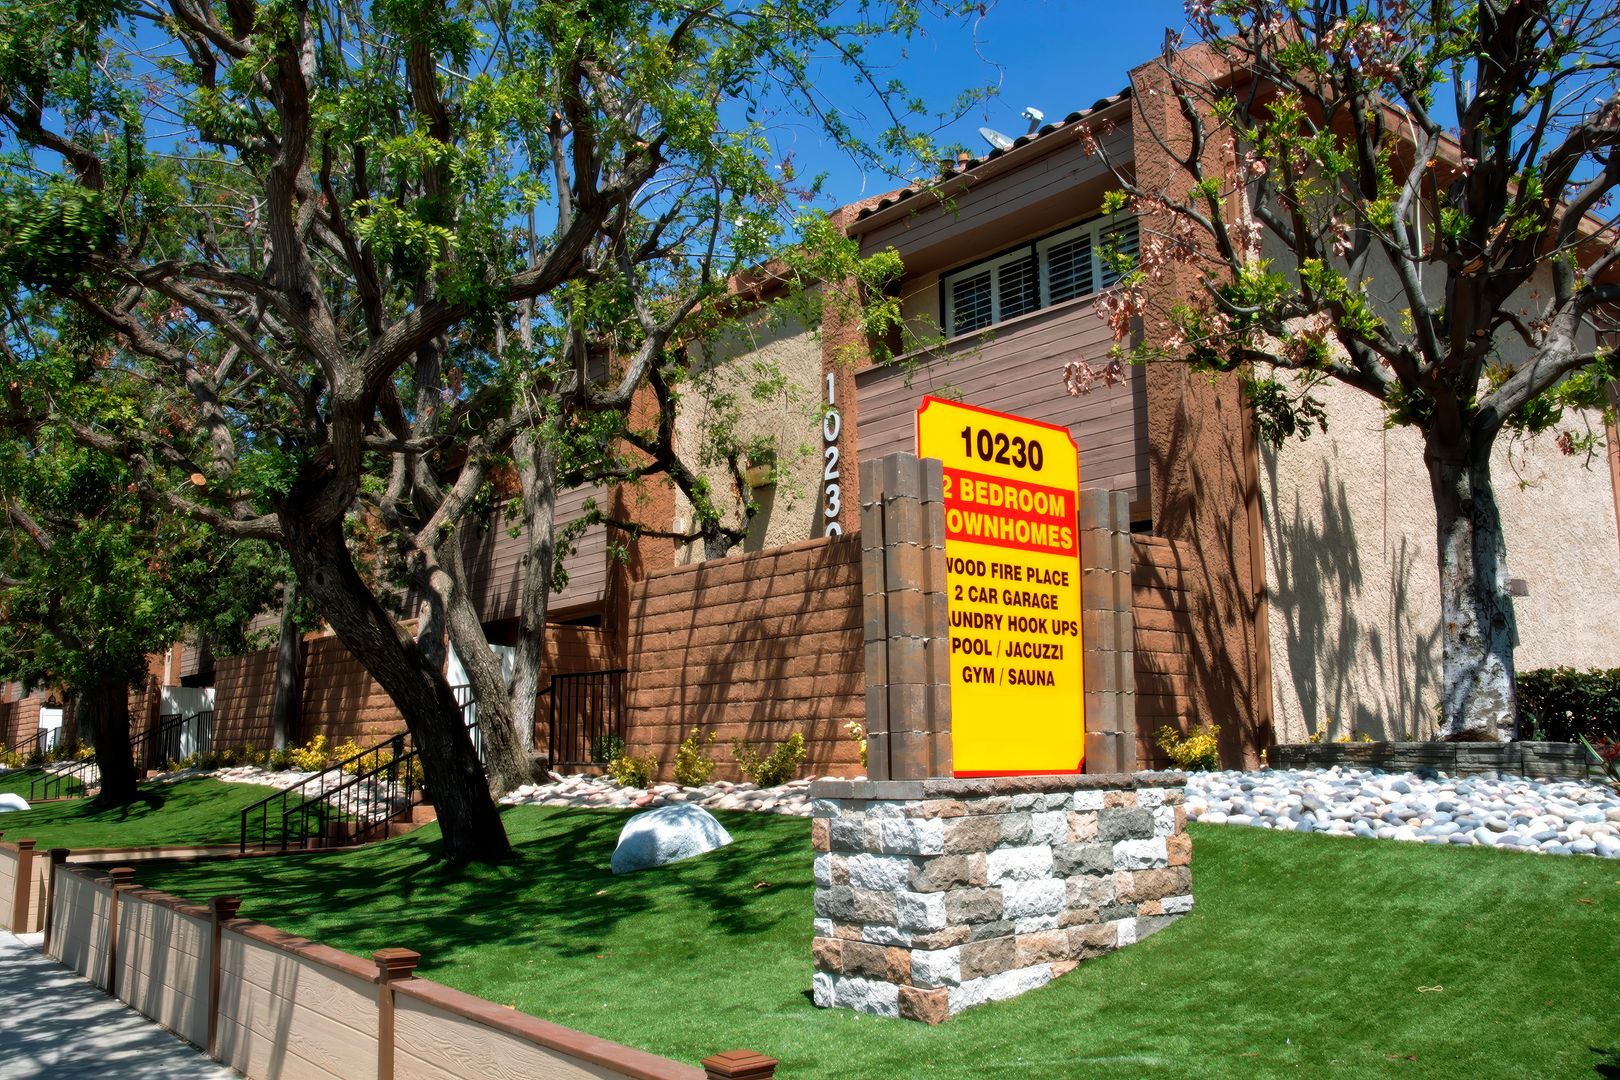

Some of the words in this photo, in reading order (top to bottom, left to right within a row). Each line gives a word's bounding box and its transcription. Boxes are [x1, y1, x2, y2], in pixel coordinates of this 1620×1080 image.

[961, 425, 1044, 472] 10230
[943, 474, 953, 499] 2
[960, 477, 1065, 518] BEDROOM
[944, 508, 1073, 550] OWNHOMES
[991, 562, 1022, 582] FIRE
[1026, 566, 1069, 587] PLACE
[954, 584, 964, 601] 2
[968, 585, 998, 604] CAR
[1002, 589, 1059, 611] GARAGE
[948, 610, 1004, 631] UNDRY
[1008, 615, 1048, 635] HOOK
[1052, 619, 1078, 637] UPS
[951, 637, 992, 656] POOL
[1005, 641, 1064, 660] JACUZZI
[962, 665, 995, 684] GYM
[1008, 668, 1055, 687] SAUNA
